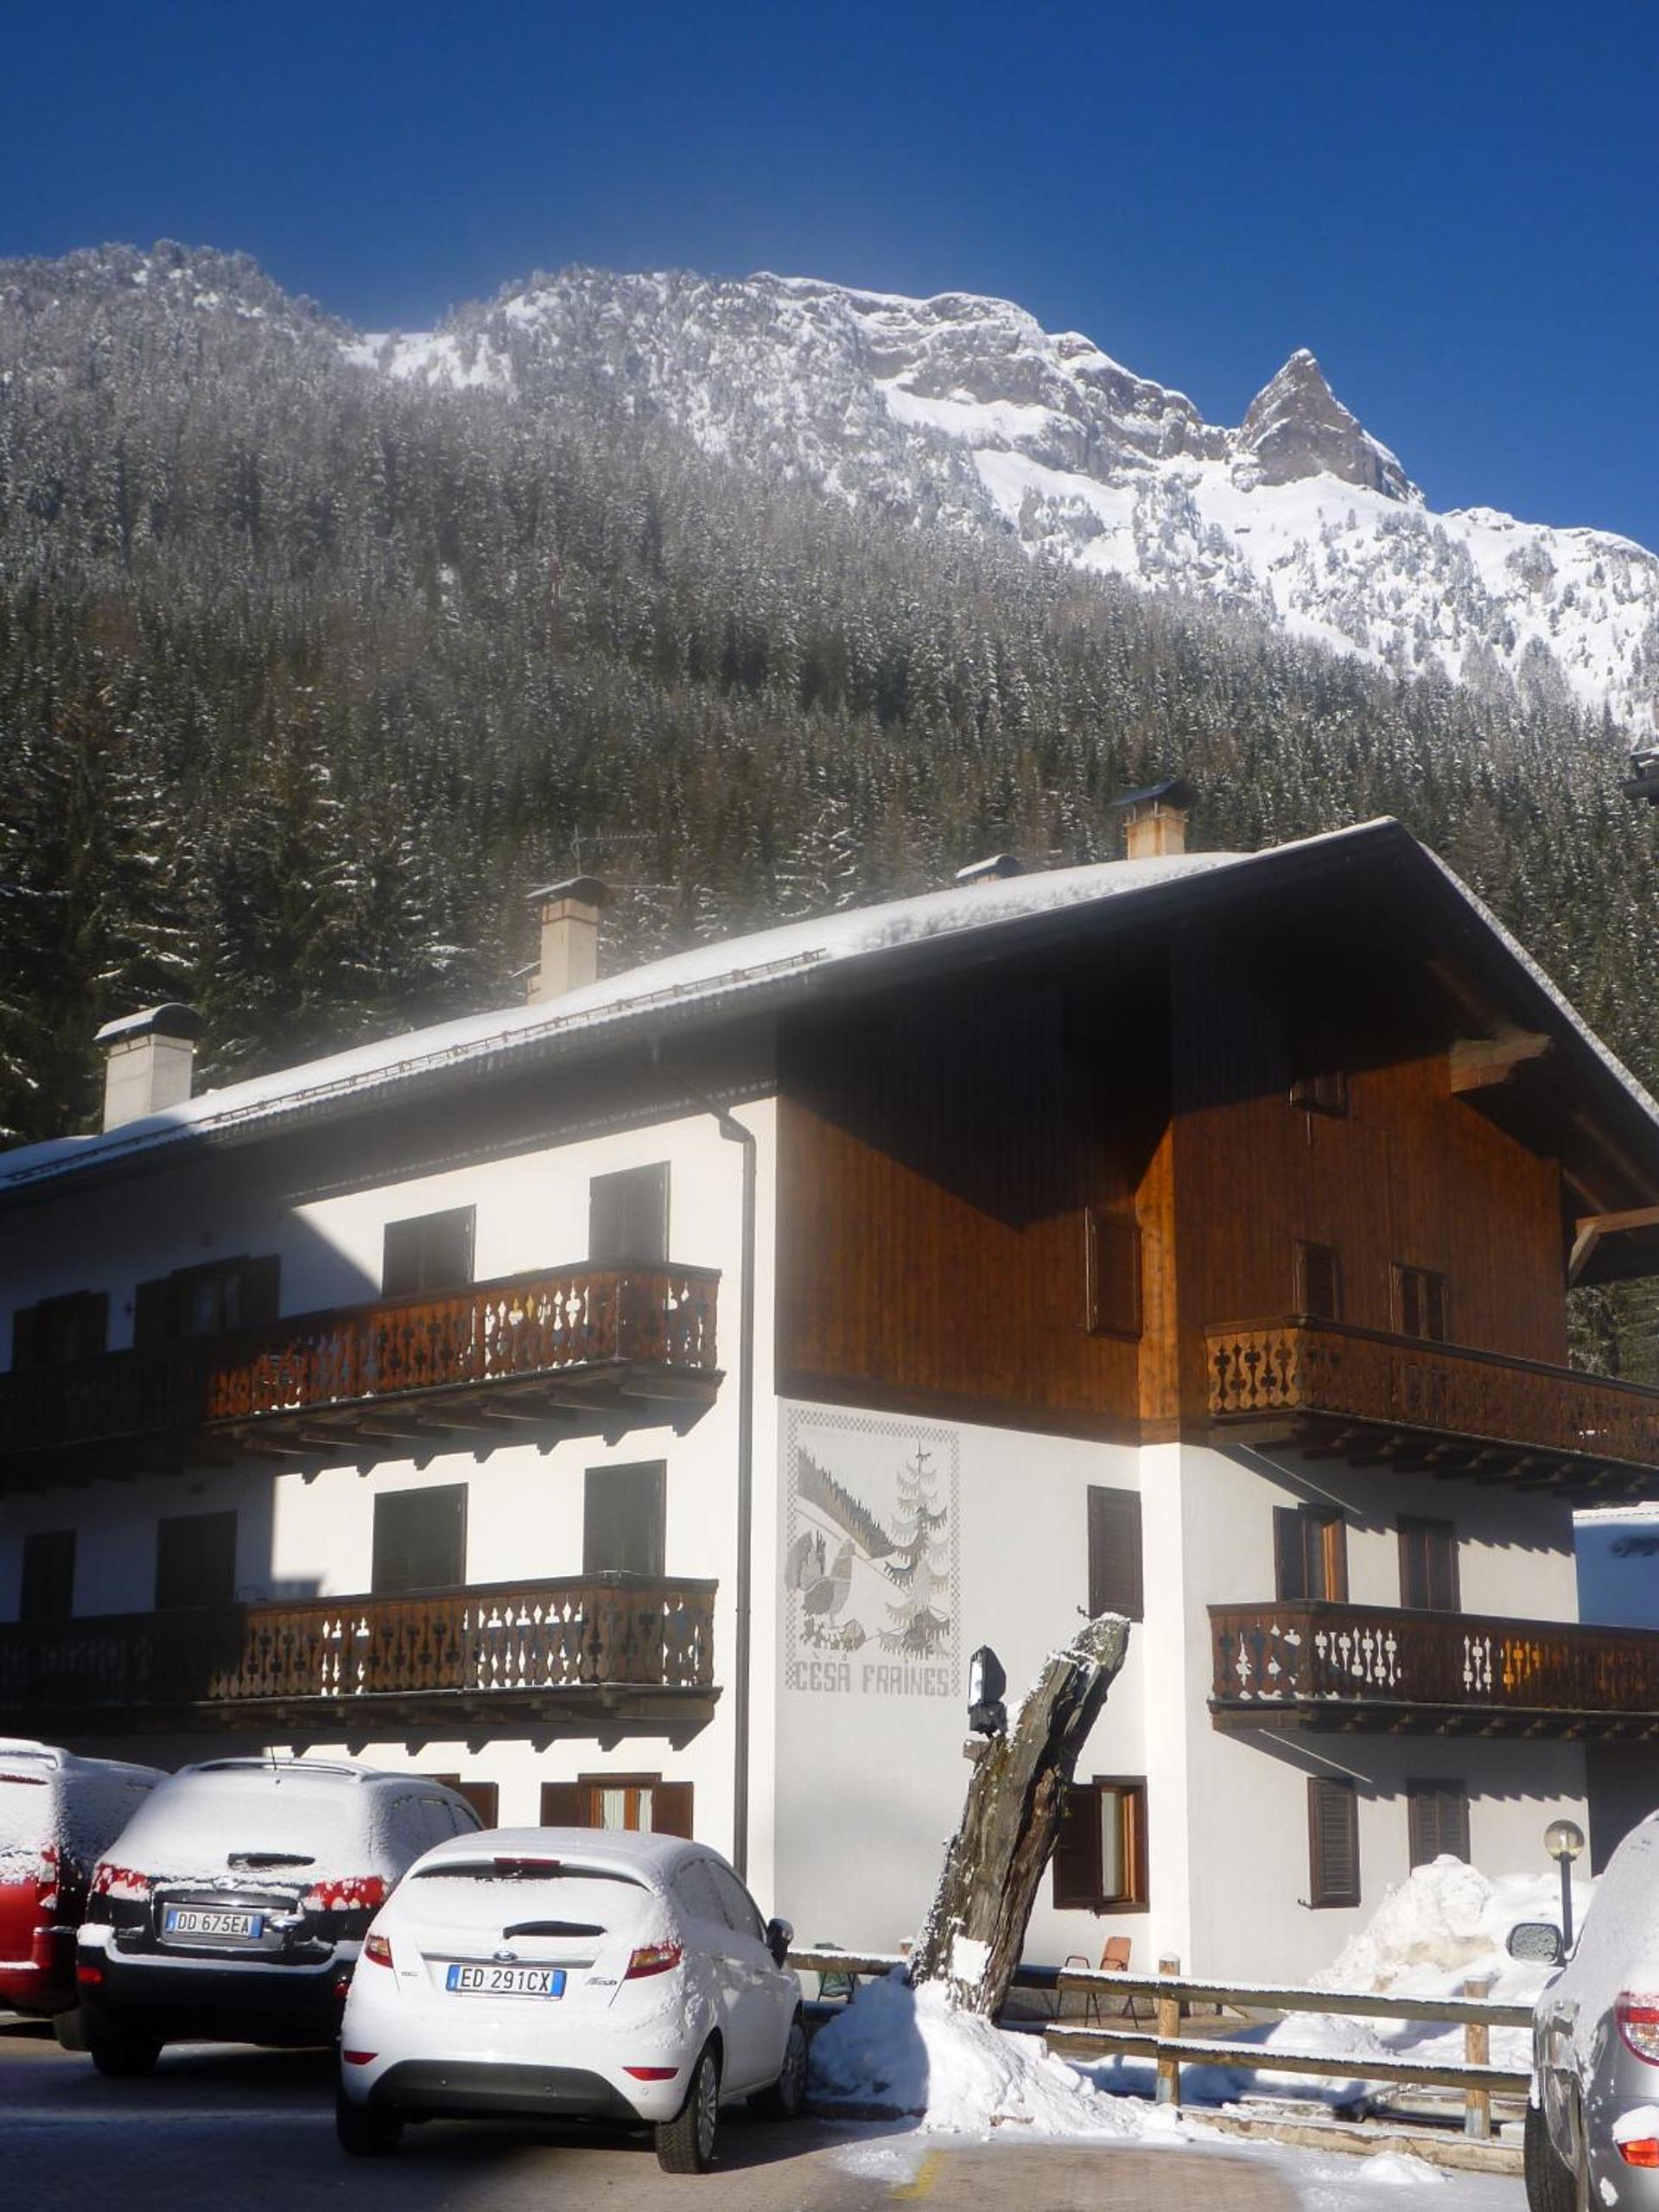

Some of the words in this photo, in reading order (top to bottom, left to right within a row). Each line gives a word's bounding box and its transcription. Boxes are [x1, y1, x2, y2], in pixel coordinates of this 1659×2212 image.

[178, 1913, 197, 1929] DD
[201, 1915, 249, 1934] 675EA
[461, 1968, 485, 1987] ED
[491, 1970, 551, 1992] 291CX
